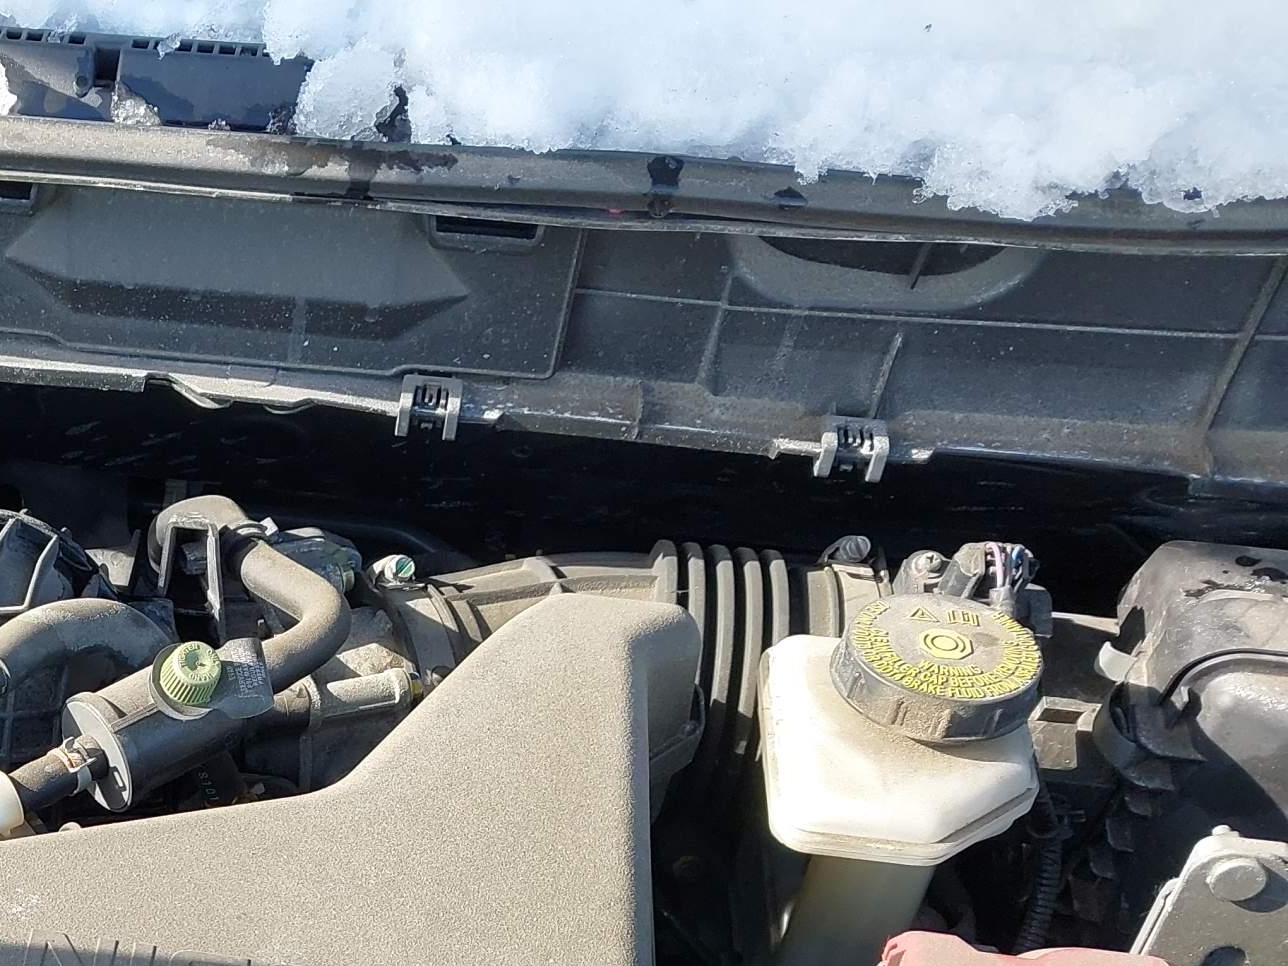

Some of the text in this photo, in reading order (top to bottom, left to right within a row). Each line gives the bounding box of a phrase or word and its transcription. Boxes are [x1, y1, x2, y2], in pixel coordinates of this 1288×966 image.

[880, 651, 922, 678] FILLER
[917, 670, 948, 685] CAP
[950, 669, 1003, 689] BEFORE
[920, 660, 983, 676] WARNING
[898, 676, 945, 696] BRAKE
[949, 685, 988, 698] FLUID
